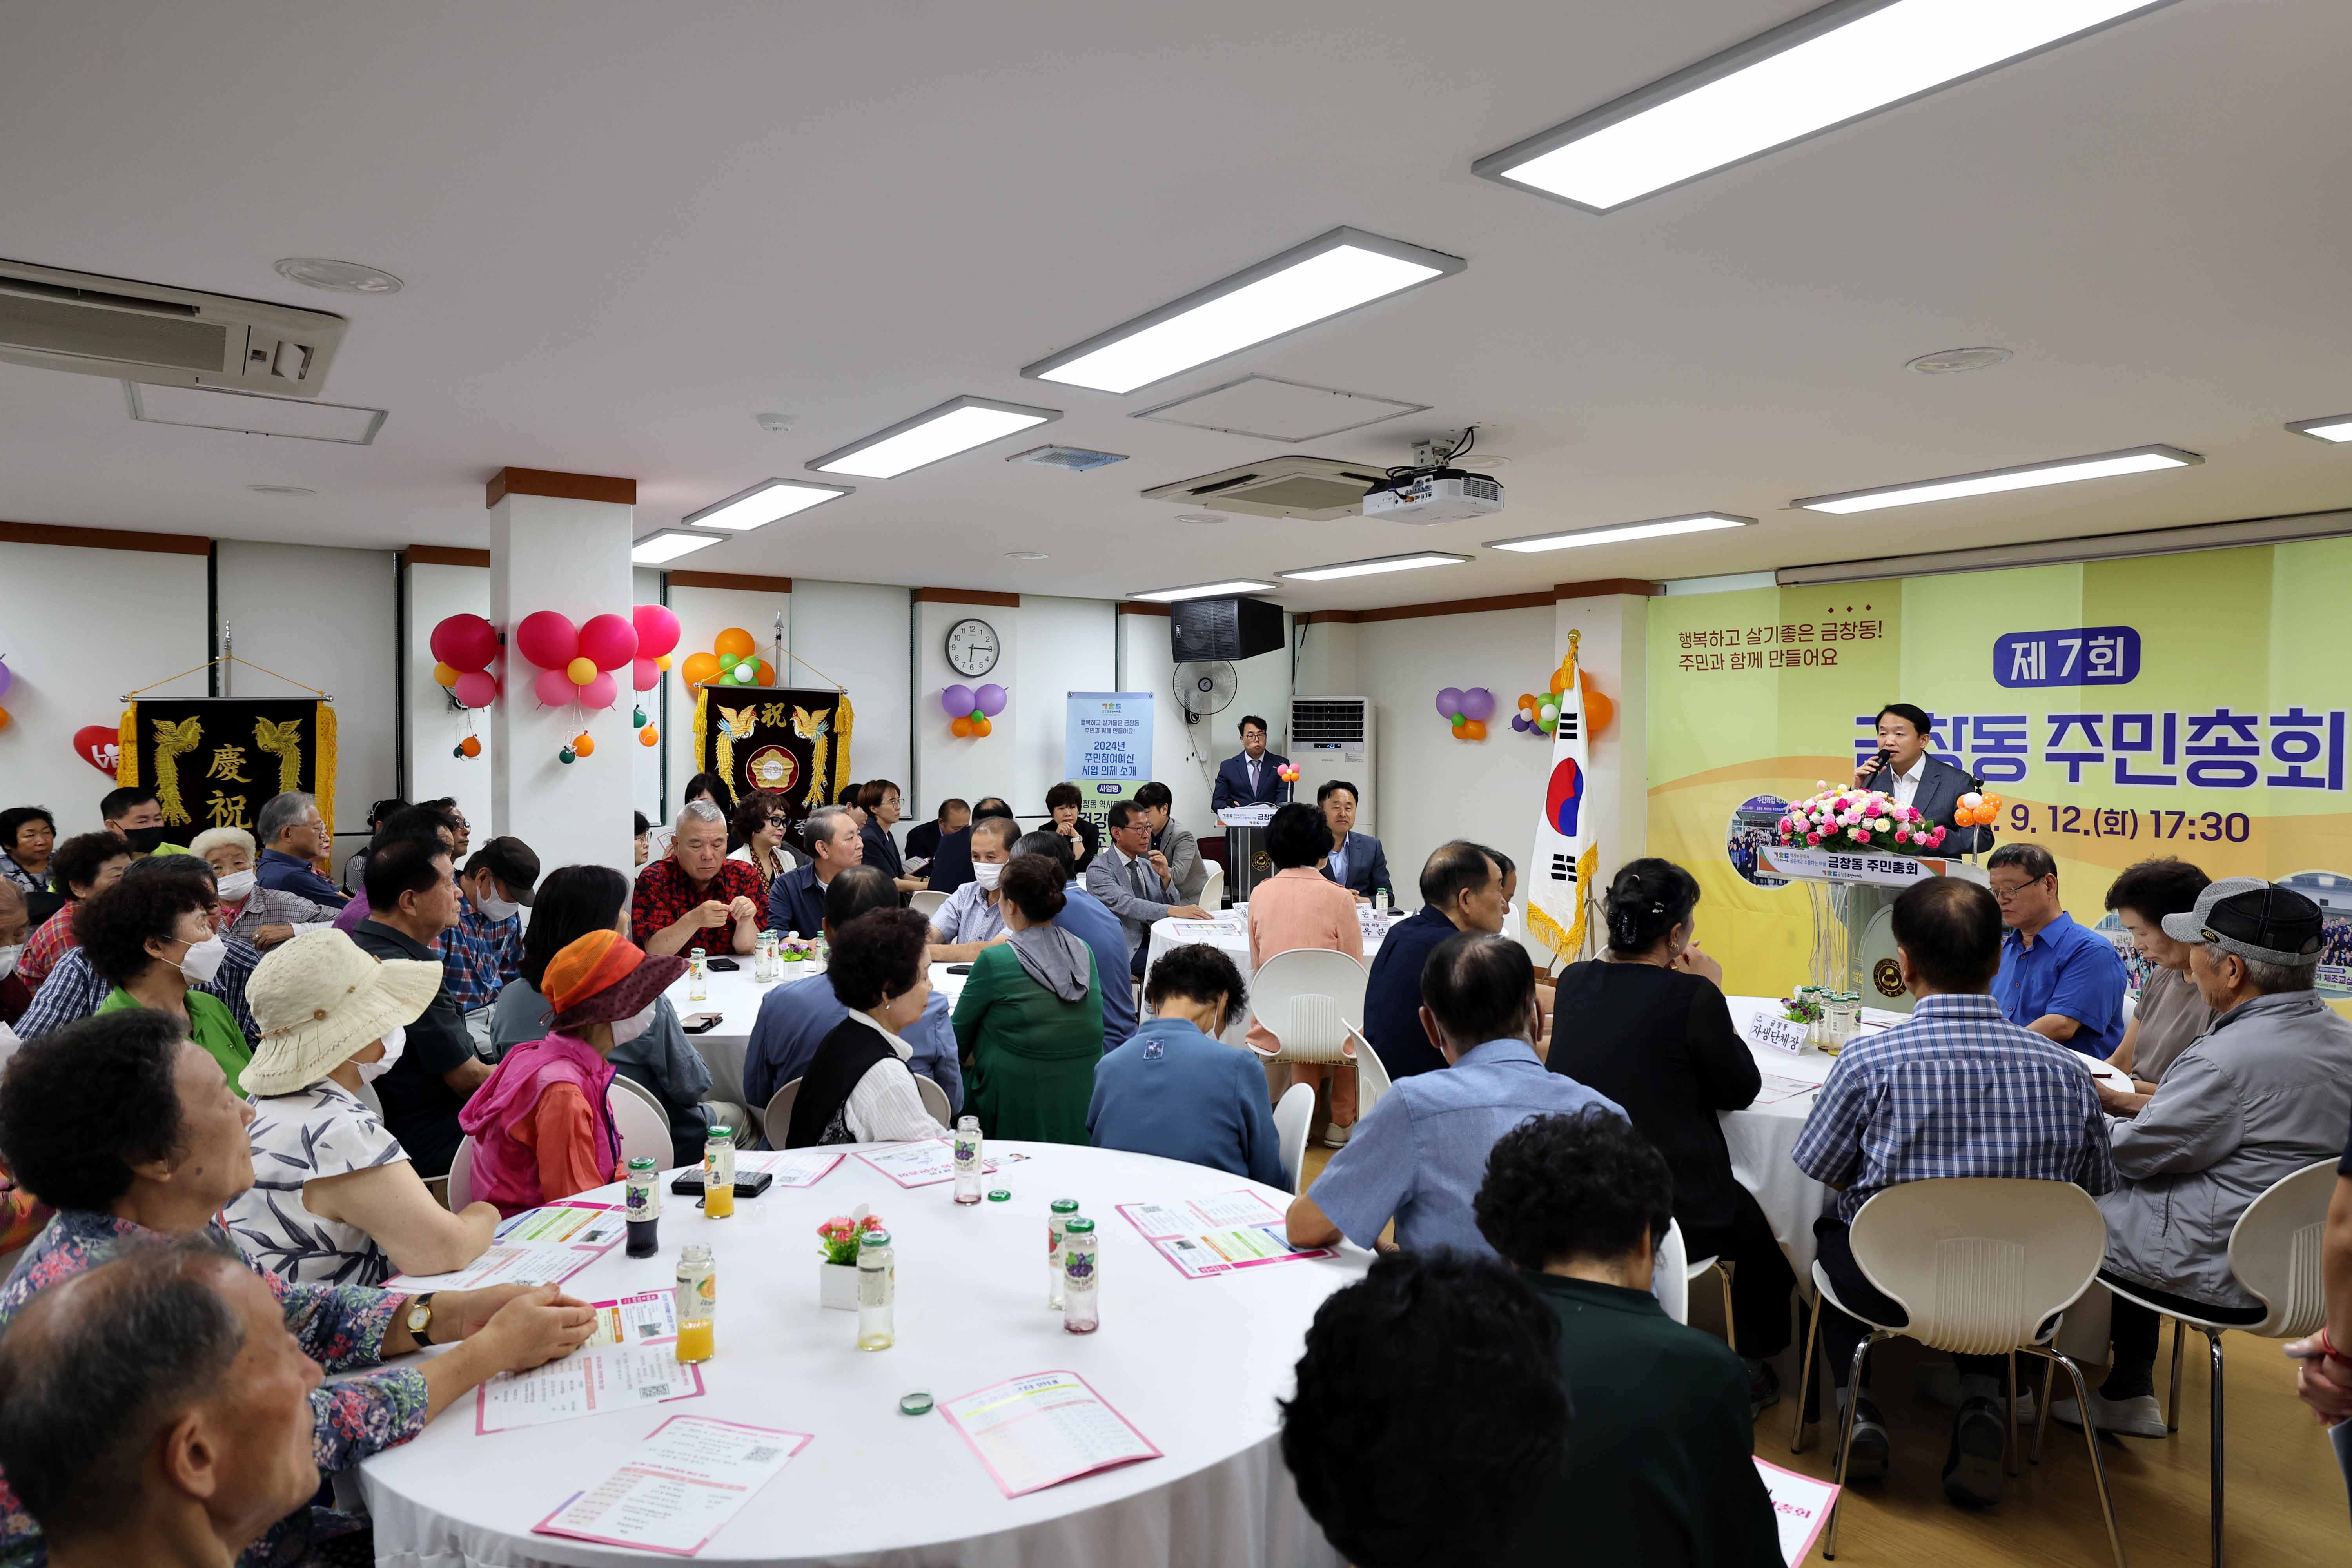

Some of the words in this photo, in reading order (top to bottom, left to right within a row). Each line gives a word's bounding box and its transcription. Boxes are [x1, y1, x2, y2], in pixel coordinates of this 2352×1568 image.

[1678, 629, 1740, 649] 행복하고
[1746, 624, 1815, 645] 살기좋은
[1821, 620, 1882, 641] 금창동!
[1679, 653, 1725, 671] 주민과
[1730, 651, 1763, 670] 함께
[1769, 648, 1838, 668] 만들어요
[2011, 641, 2046, 680] 제
[2057, 635, 2125, 677] 7회
[761, 702, 787, 728] 祝
[1094, 741, 1125, 751] 2024년
[2045, 708, 2344, 791] 주민총회
[1085, 753, 1135, 764] 주민참여예산
[1082, 765, 1098, 775] 사업
[1101, 766, 1117, 776] 의제
[1120, 766, 1136, 776] 소개
[1081, 799, 1096, 809] 창동
[2150, 809, 2250, 843] 17:30
[1828, 856, 1863, 870] 금창동
[1867, 858, 1918, 875] 주민총회
[1751, 1024, 1799, 1050] 자생단체장
[1772, 1501, 1811, 1519] 총회
